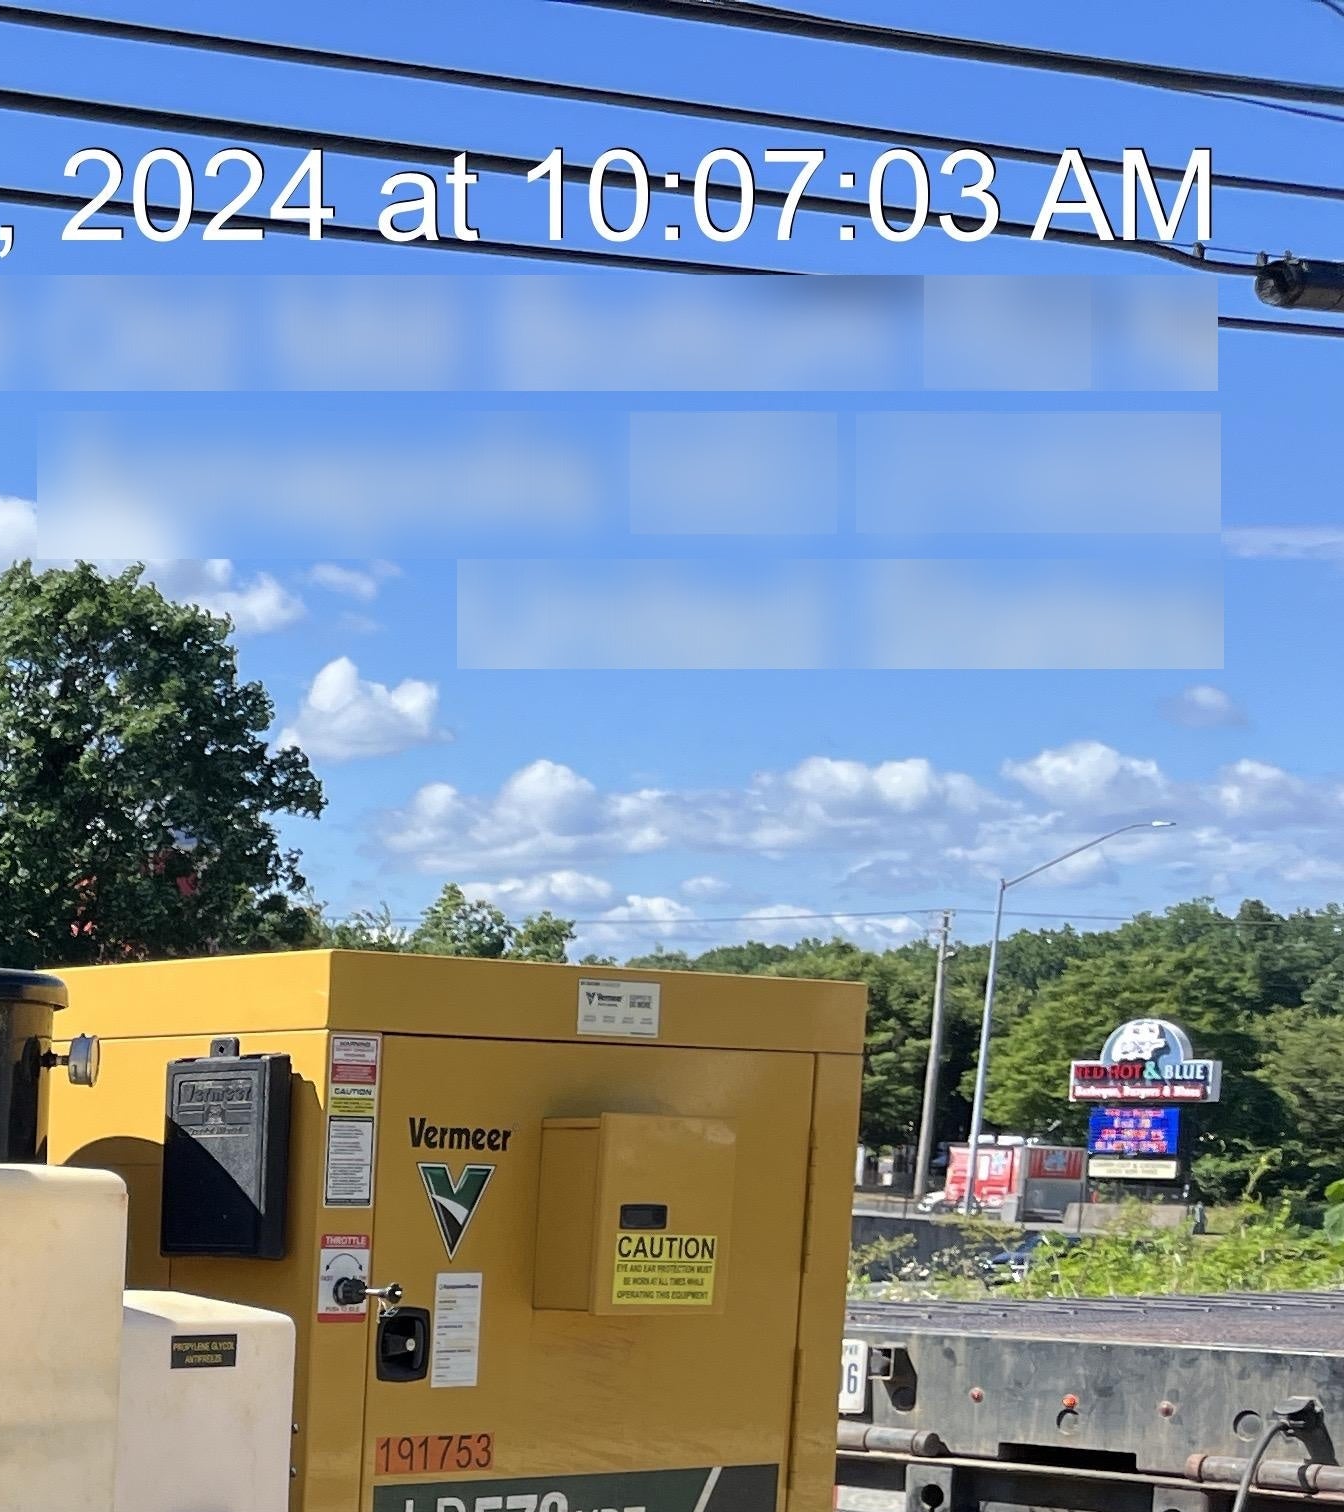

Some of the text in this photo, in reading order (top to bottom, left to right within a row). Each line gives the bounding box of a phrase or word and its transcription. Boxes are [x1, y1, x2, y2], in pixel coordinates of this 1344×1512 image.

[1075, 1061, 1205, 1080] RED HOT & BLUE
[334, 1087, 372, 1096] CAUTION
[409, 1117, 512, 1151] Vermeer
[325, 1235, 367, 1245] THROTTLE
[618, 1236, 715, 1259] CAUTION
[657, 1265, 695, 1273] PROTECTION
[617, 1290, 708, 1299] OPERATING THIS EQUIPMENT
[379, 1433, 493, 1473] 191753
